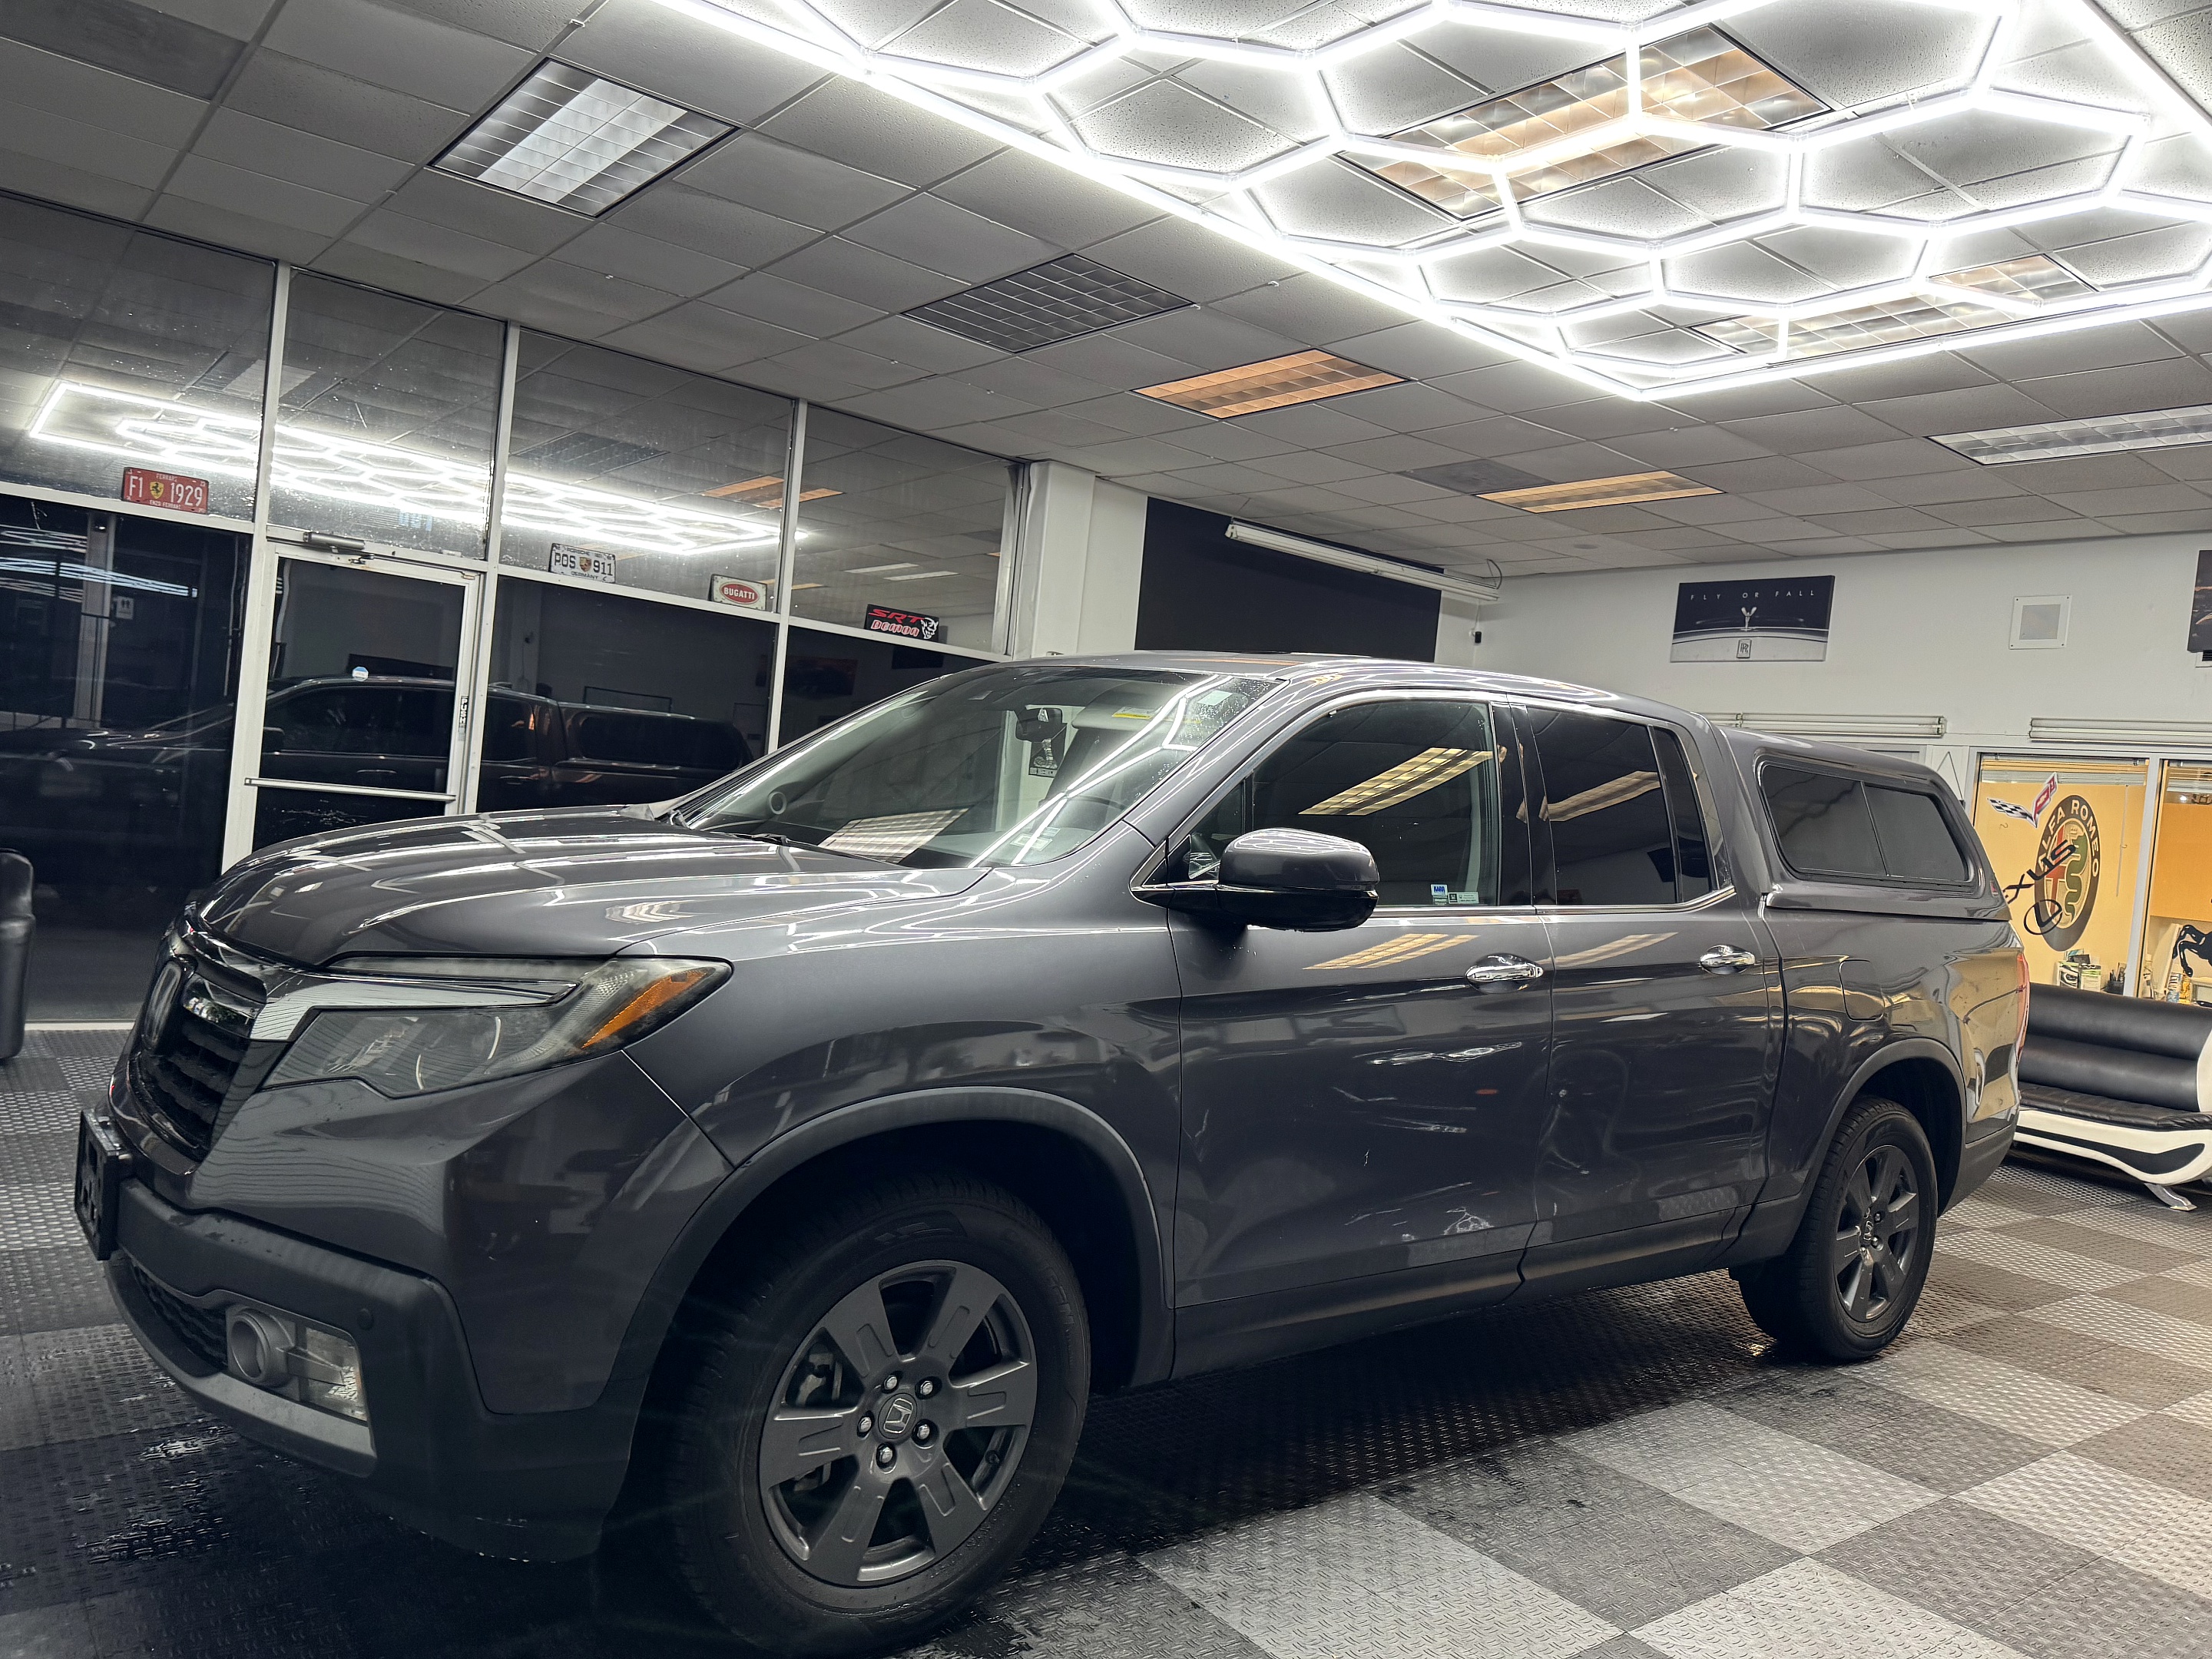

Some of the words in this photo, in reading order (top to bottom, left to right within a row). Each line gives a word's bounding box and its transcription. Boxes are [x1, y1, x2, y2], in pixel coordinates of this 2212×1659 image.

[129, 475, 143, 498] F1
[170, 482, 203, 507] 1929
[555, 552, 576, 568] POS
[593, 559, 613, 576] 911
[571, 571, 599, 580] GERMANY
[724, 587, 755, 600] BUGATTI
[1775, 589, 1814, 598] FALL
[868, 608, 926, 624] SRT
[459, 698, 468, 724] PUSH
[2071, 800, 2099, 877] ROMEO
